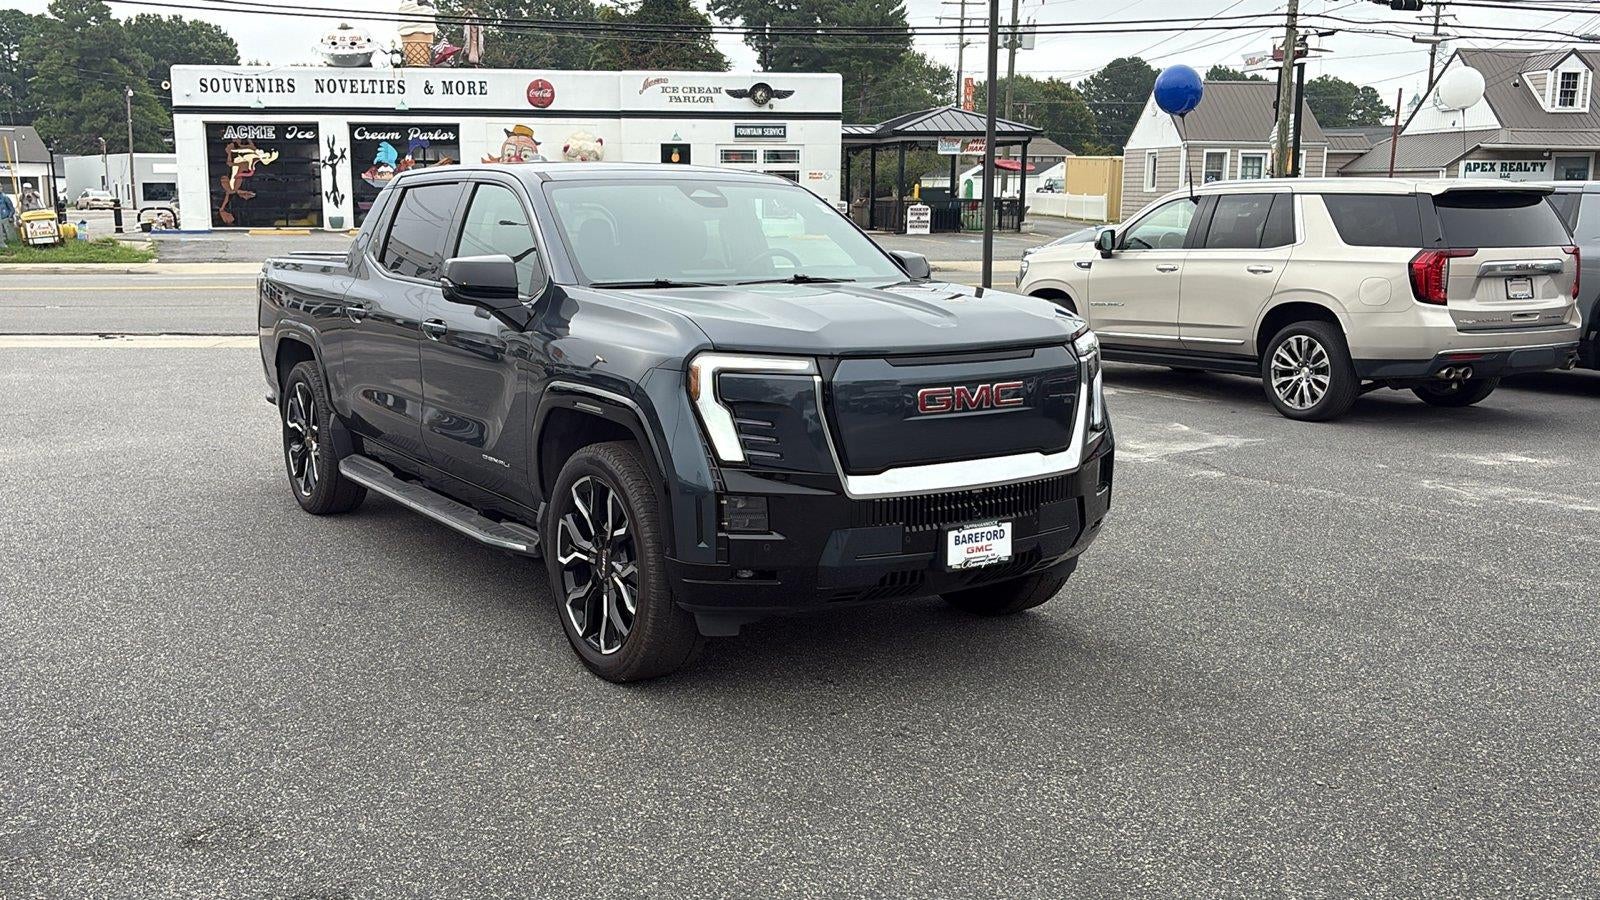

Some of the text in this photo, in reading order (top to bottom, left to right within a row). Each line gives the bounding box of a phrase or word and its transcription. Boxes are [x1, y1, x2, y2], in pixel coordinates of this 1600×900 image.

[199, 77, 488, 95] SOUVENIRS NOVELTIES & MORE
[661, 86, 722, 94] ICE CREAM
[668, 95, 714, 103] PARLOR
[224, 126, 456, 140] ACME Ice Cream Parlor
[736, 127, 784, 136] FOUNTAIN SERVICE
[1464, 162, 1547, 172] APEX REALTY
[917, 381, 1024, 413] GMC
[954, 529, 1006, 546] BAREFORD
[966, 544, 993, 554] GMC
